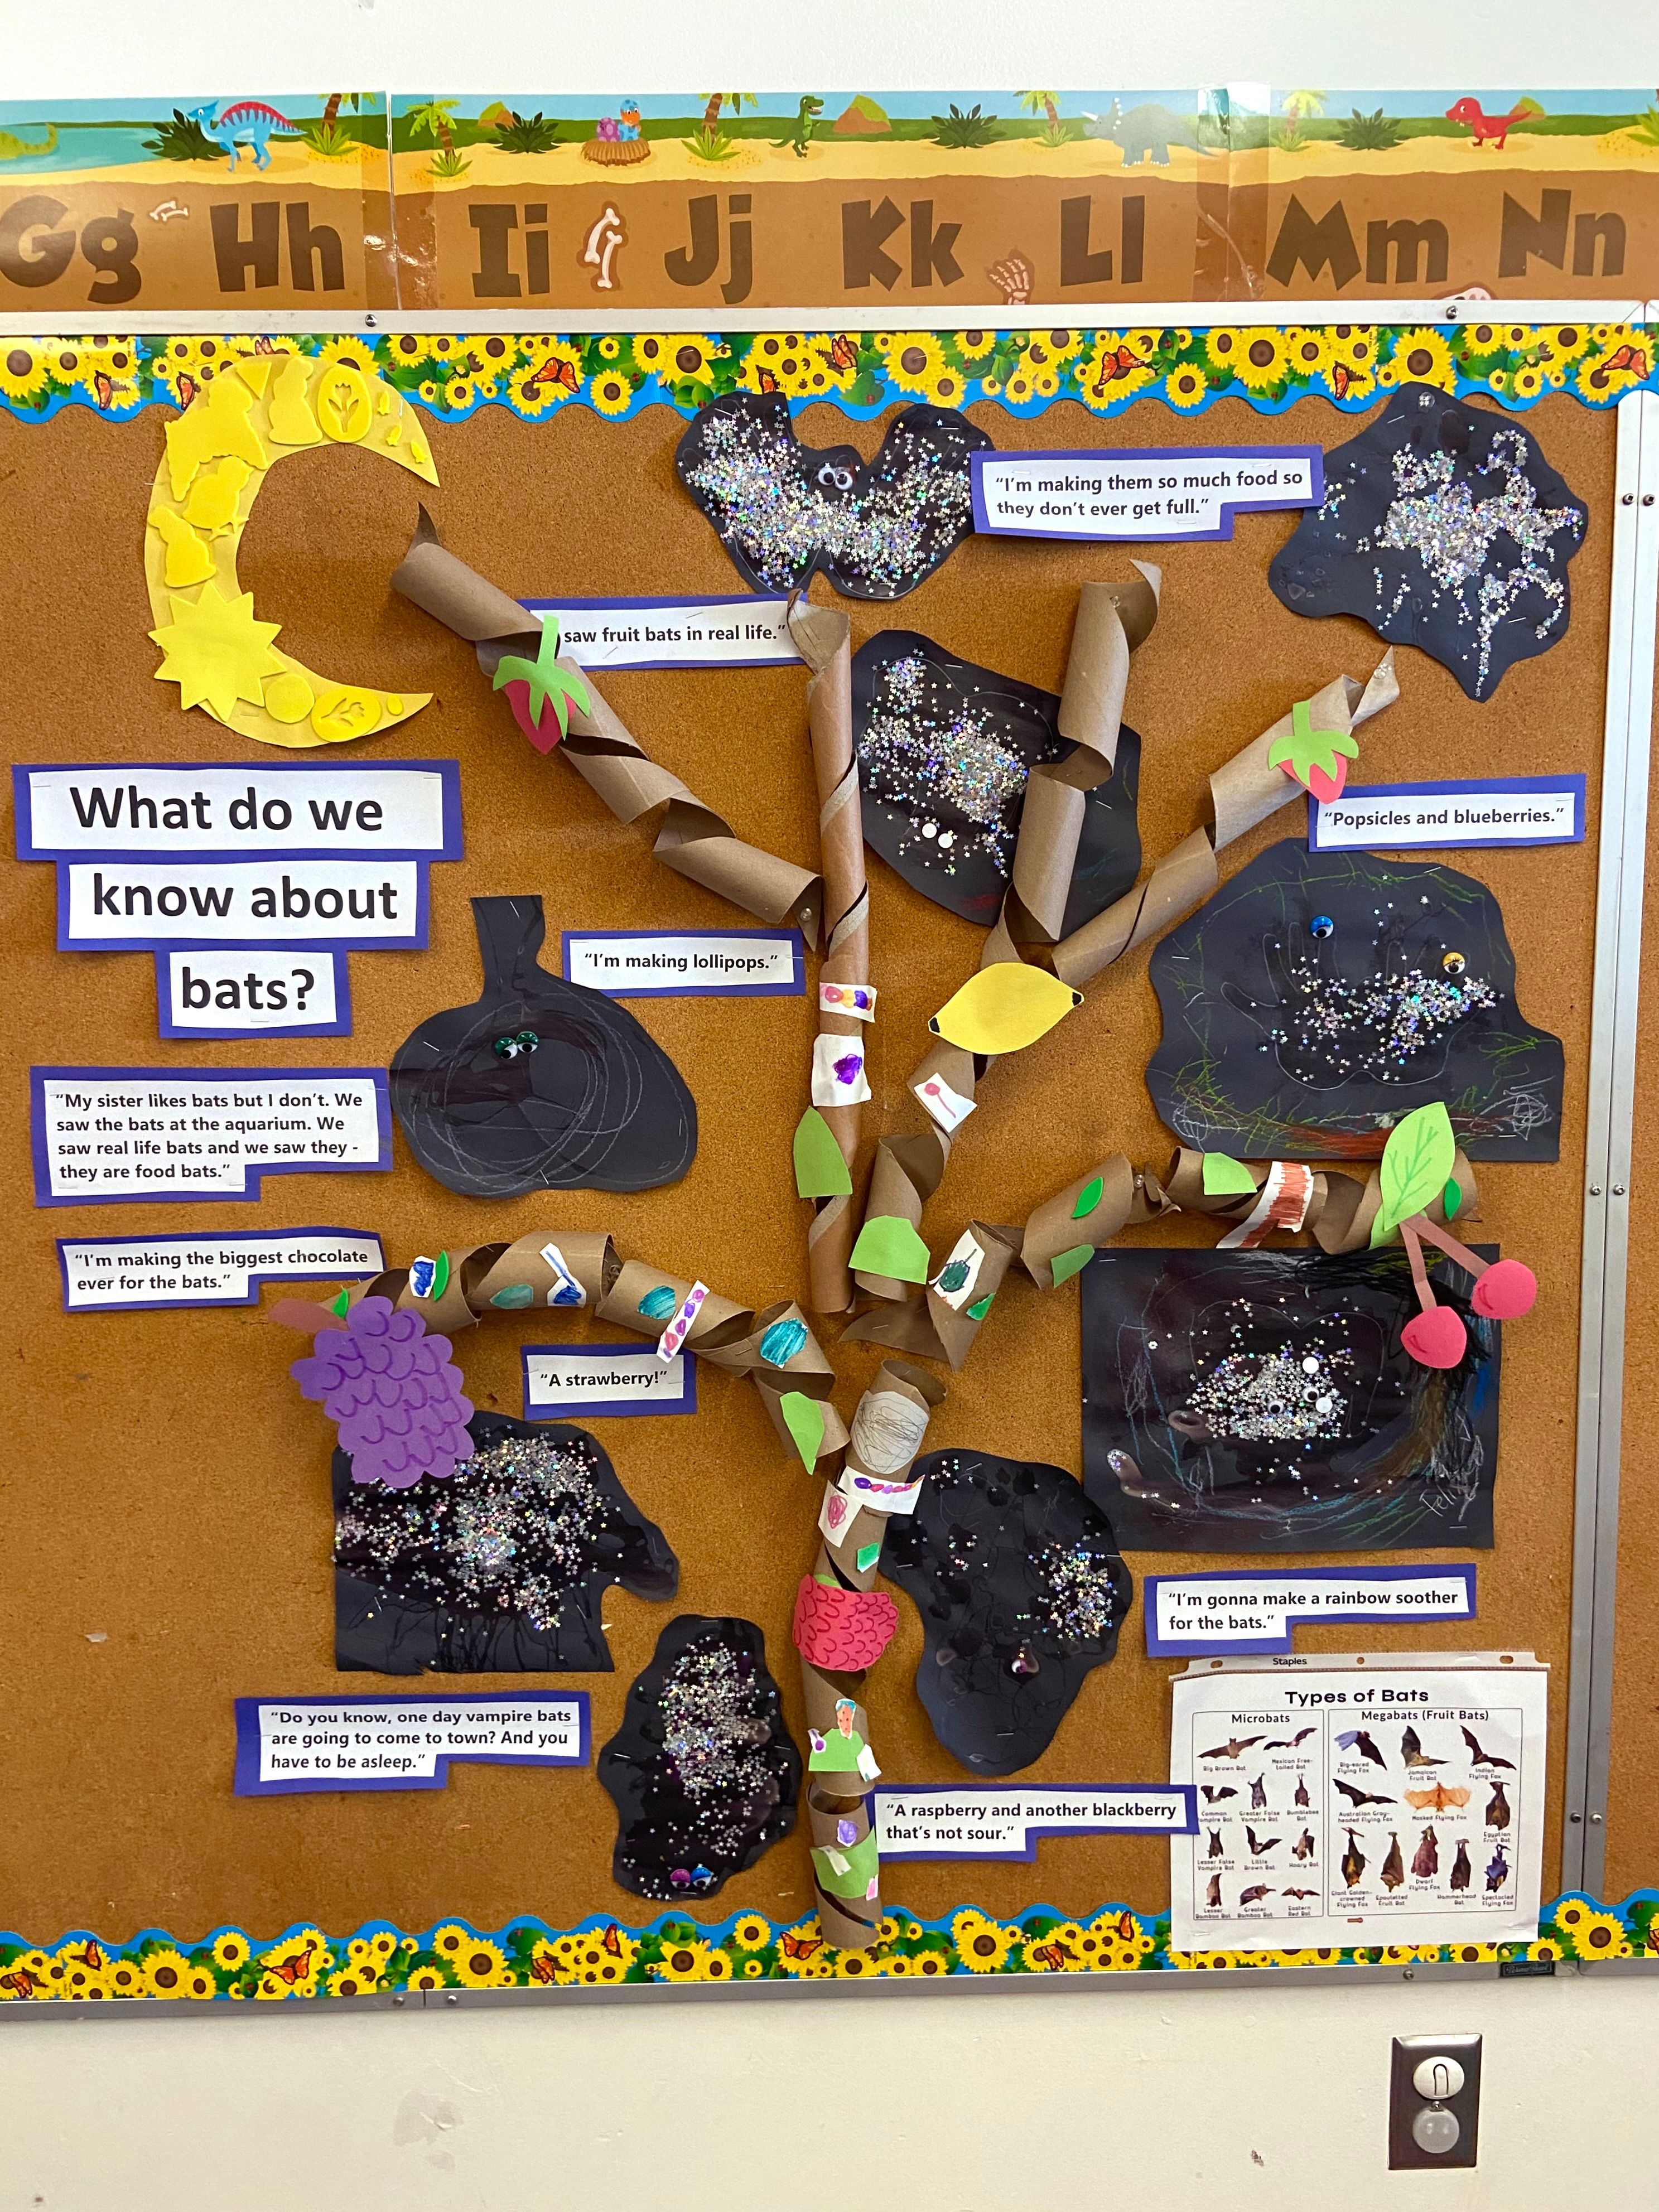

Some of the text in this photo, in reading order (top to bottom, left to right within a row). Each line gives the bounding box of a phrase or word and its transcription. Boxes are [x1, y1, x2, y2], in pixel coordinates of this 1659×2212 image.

[842, 195, 964, 290] Kk
[1060, 195, 1145, 287] Ll
[1266, 194, 1449, 290] Mm
[1498, 189, 1627, 278] Nn
[0, 195, 142, 304] Gg
[210, 200, 345, 292] Hh
[469, 202, 551, 297] Ii
[664, 194, 752, 304] Jj
[996, 470, 1302, 494] “I’m making them so much food so
[997, 499, 1208, 519] they don’t ever get full.”
[565, 625, 785, 643] saw fruit bats in real life.”
[70, 785, 382, 831] What do we
[1325, 808, 1564, 829] “Popsicles and blueberries.”
[94, 873, 397, 919] know about
[585, 954, 778, 972] “I’m making lollipops.”
[182, 967, 314, 1010] bats?
[56, 1093, 362, 1111] “My sister likes bats but I don’t. We
[57, 1117, 344, 1134] saw the bats at the aquarium. We
[59, 1145, 90, 1155] saw
[98, 1141, 128, 1154] real
[134, 1141, 161, 1154] life
[167, 1141, 202, 1153] bats
[208, 1141, 239, 1153] and
[245, 1144, 268, 1153] we
[274, 1144, 305, 1153] saw
[311, 1140, 347, 1157] they
[60, 1164, 229, 1182] they are food bats.”
[75, 1249, 368, 1268] “I’m making the biggest chocolate
[78, 1274, 230, 1289] ever for the bats.”
[541, 1371, 667, 1388] “A strawberry!”
[1169, 1591, 1458, 1609] “I’m gonna make a rainbow soother
[1169, 1615, 1274, 1629] for the bats.”
[1273, 1658, 1307, 1667] Staples
[1285, 1689, 1428, 1707] Types of Bats
[272, 1712, 302, 1722] “Do
[308, 1715, 337, 1726] you
[344, 1712, 391, 1724] know,
[433, 1711, 461, 1725] day
[466, 1710, 532, 1725] vampire
[538, 1710, 570, 1721] bats
[1232, 1714, 1290, 1723] Microbats
[1362, 1710, 1488, 1721] Megabats (Fruit Bats)
[272, 1731, 567, 1748] are going to come to town? And you
[272, 1754, 425, 1771] have to be asleep.”
[887, 1803, 1176, 1820] “A raspberry and another blackberry
[886, 1825, 1014, 1839] that’s not sour.”
